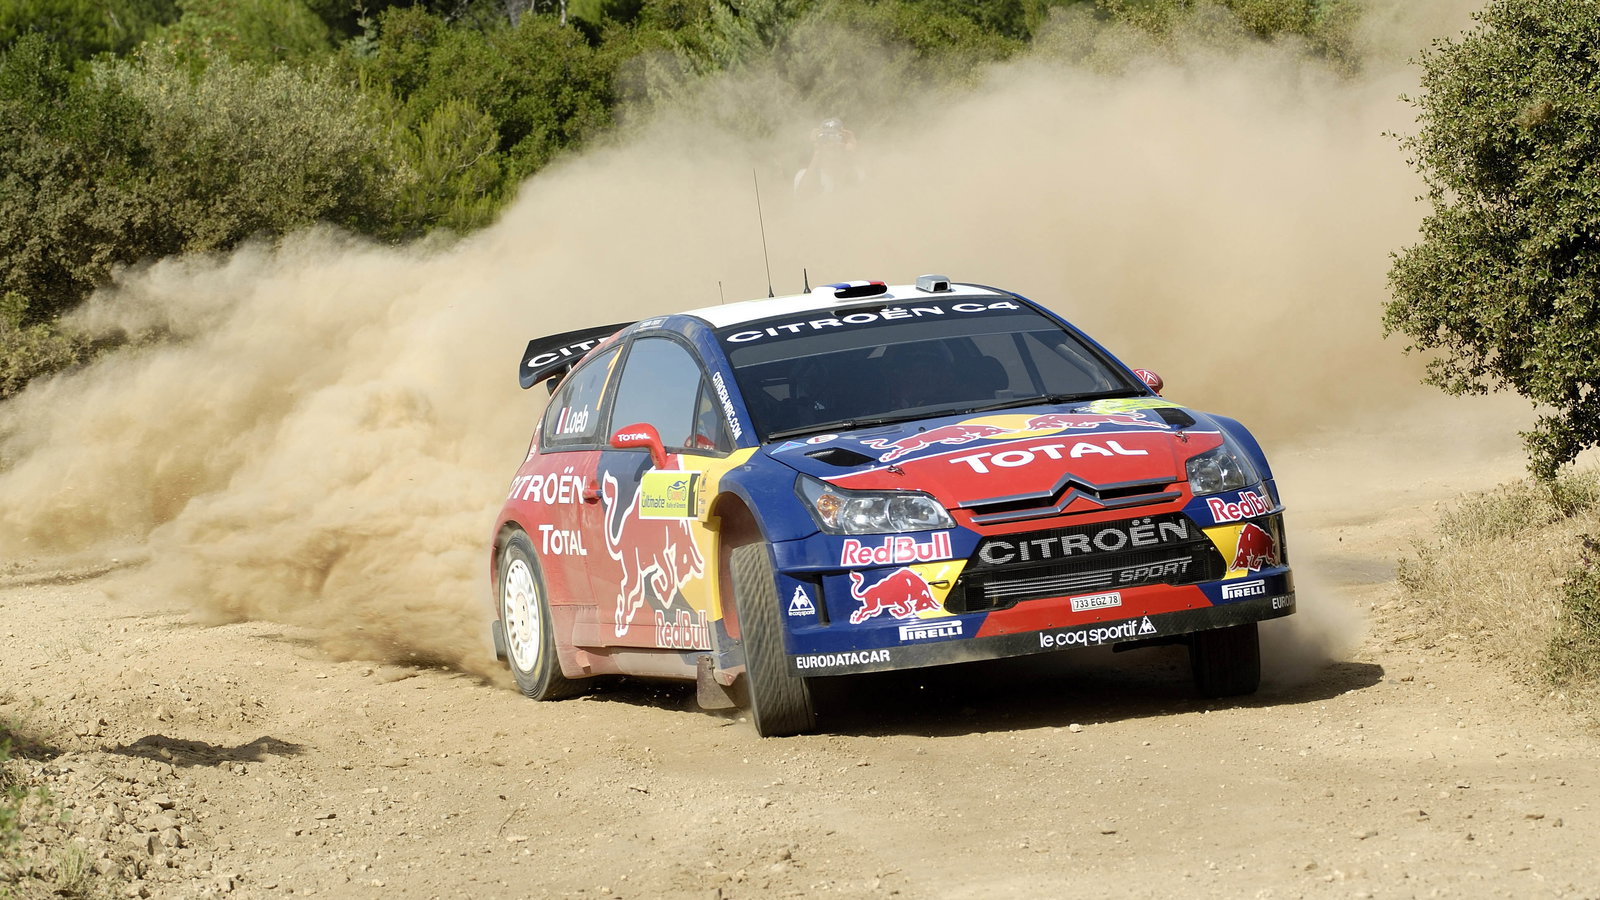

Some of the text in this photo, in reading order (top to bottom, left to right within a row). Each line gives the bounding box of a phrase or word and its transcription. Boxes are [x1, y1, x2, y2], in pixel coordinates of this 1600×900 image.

[727, 301, 1020, 343] CITROËN C4
[564, 404, 589, 434] Loeb
[618, 432, 650, 442] TOTAL
[949, 440, 1149, 474] TOTAL
[1206, 492, 1256, 523] Red
[538, 524, 587, 555] TOTAL
[840, 531, 953, 567] Red Bull
[979, 517, 1188, 565] CITROËN
[1119, 559, 1192, 582] SPORT
[1074, 596, 1119, 609] 733 EGZ 78
[1221, 579, 1265, 599] PIRELLI
[655, 609, 711, 650] Red Bull
[899, 620, 963, 641] PIRELLI
[1039, 620, 1138, 647] le coq sportif
[796, 649, 890, 669] EURODATACAR
